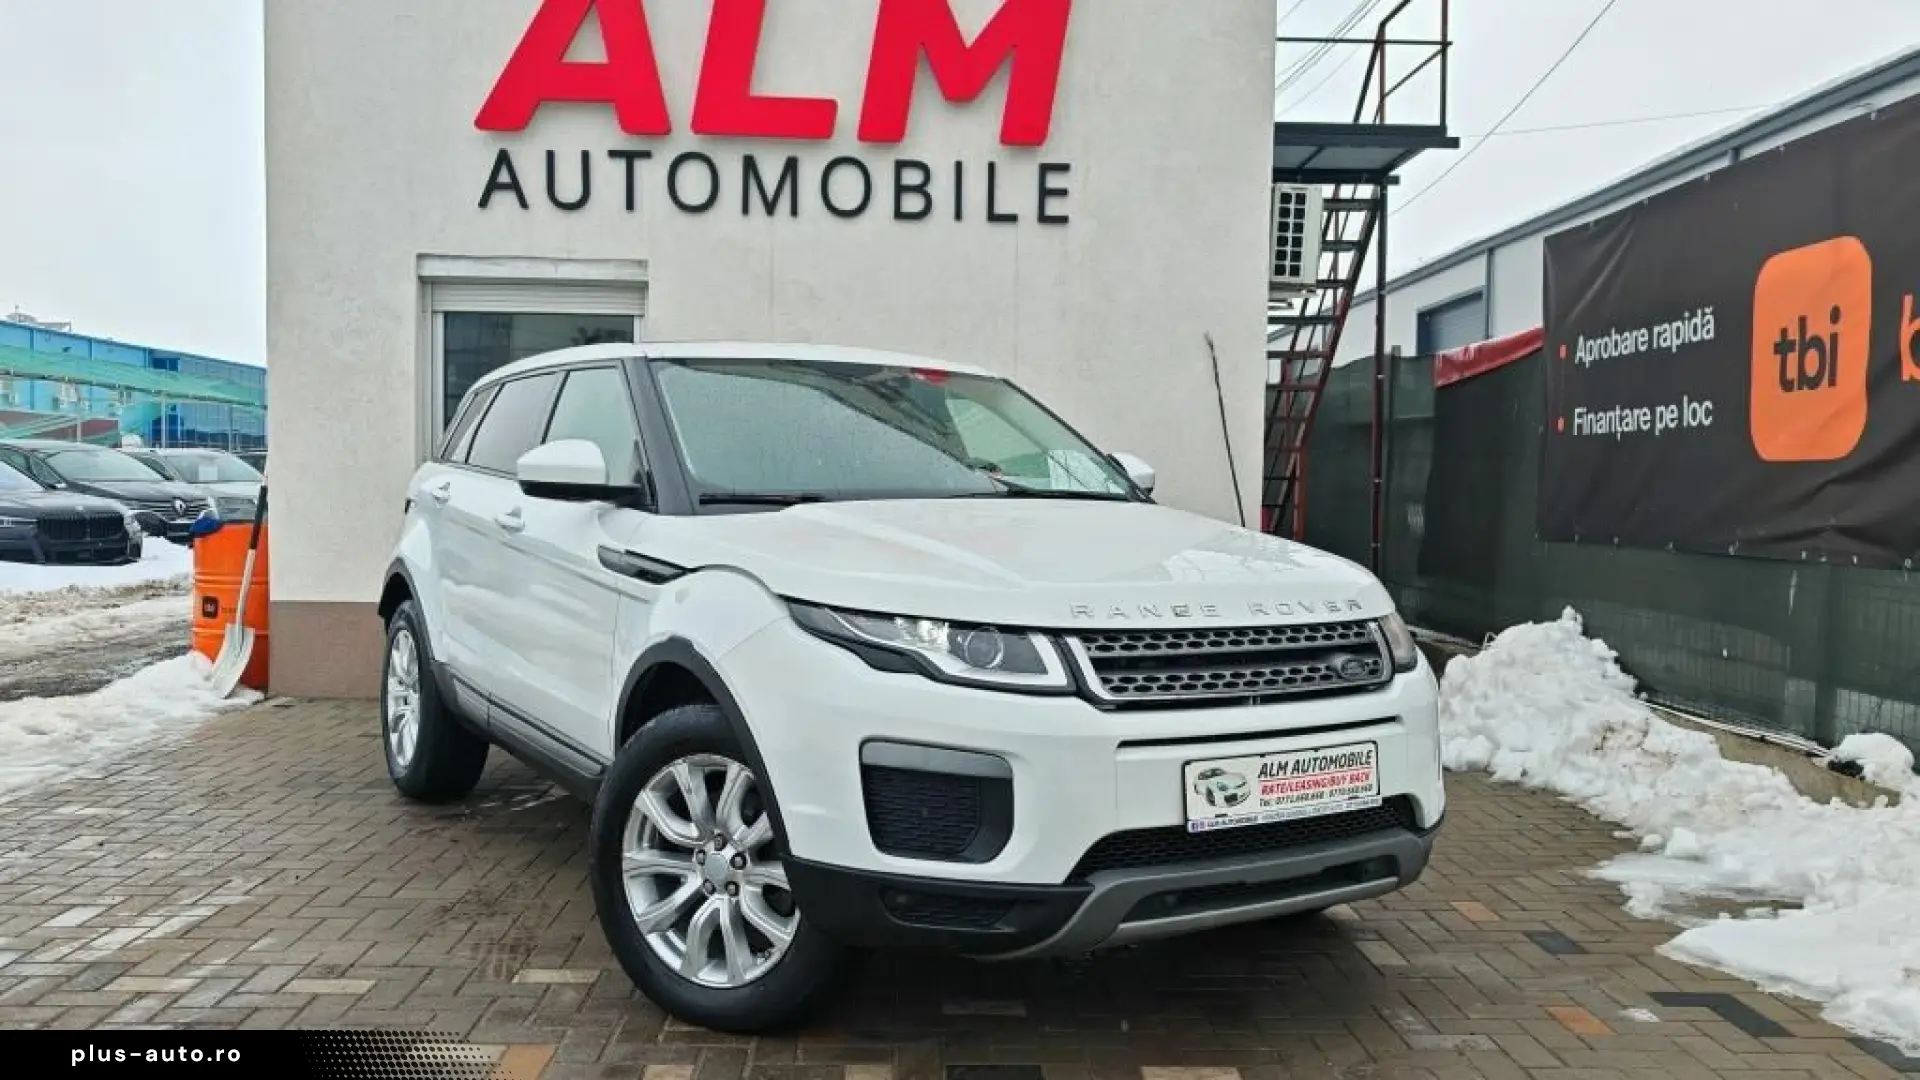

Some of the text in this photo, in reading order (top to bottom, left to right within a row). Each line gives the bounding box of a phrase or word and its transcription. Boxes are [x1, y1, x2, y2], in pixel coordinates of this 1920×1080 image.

[474, 0, 1074, 147] ALM
[477, 148, 1071, 224] AUTOMOBILE
[1574, 306, 1715, 368] Aprobare rapidă
[1773, 305, 1842, 392] tbi
[1573, 395, 1713, 441] Finanțare pe loc
[1070, 599, 1364, 618] RANGE ROVER
[1259, 750, 1371, 779] ALM AUTOMOBILE
